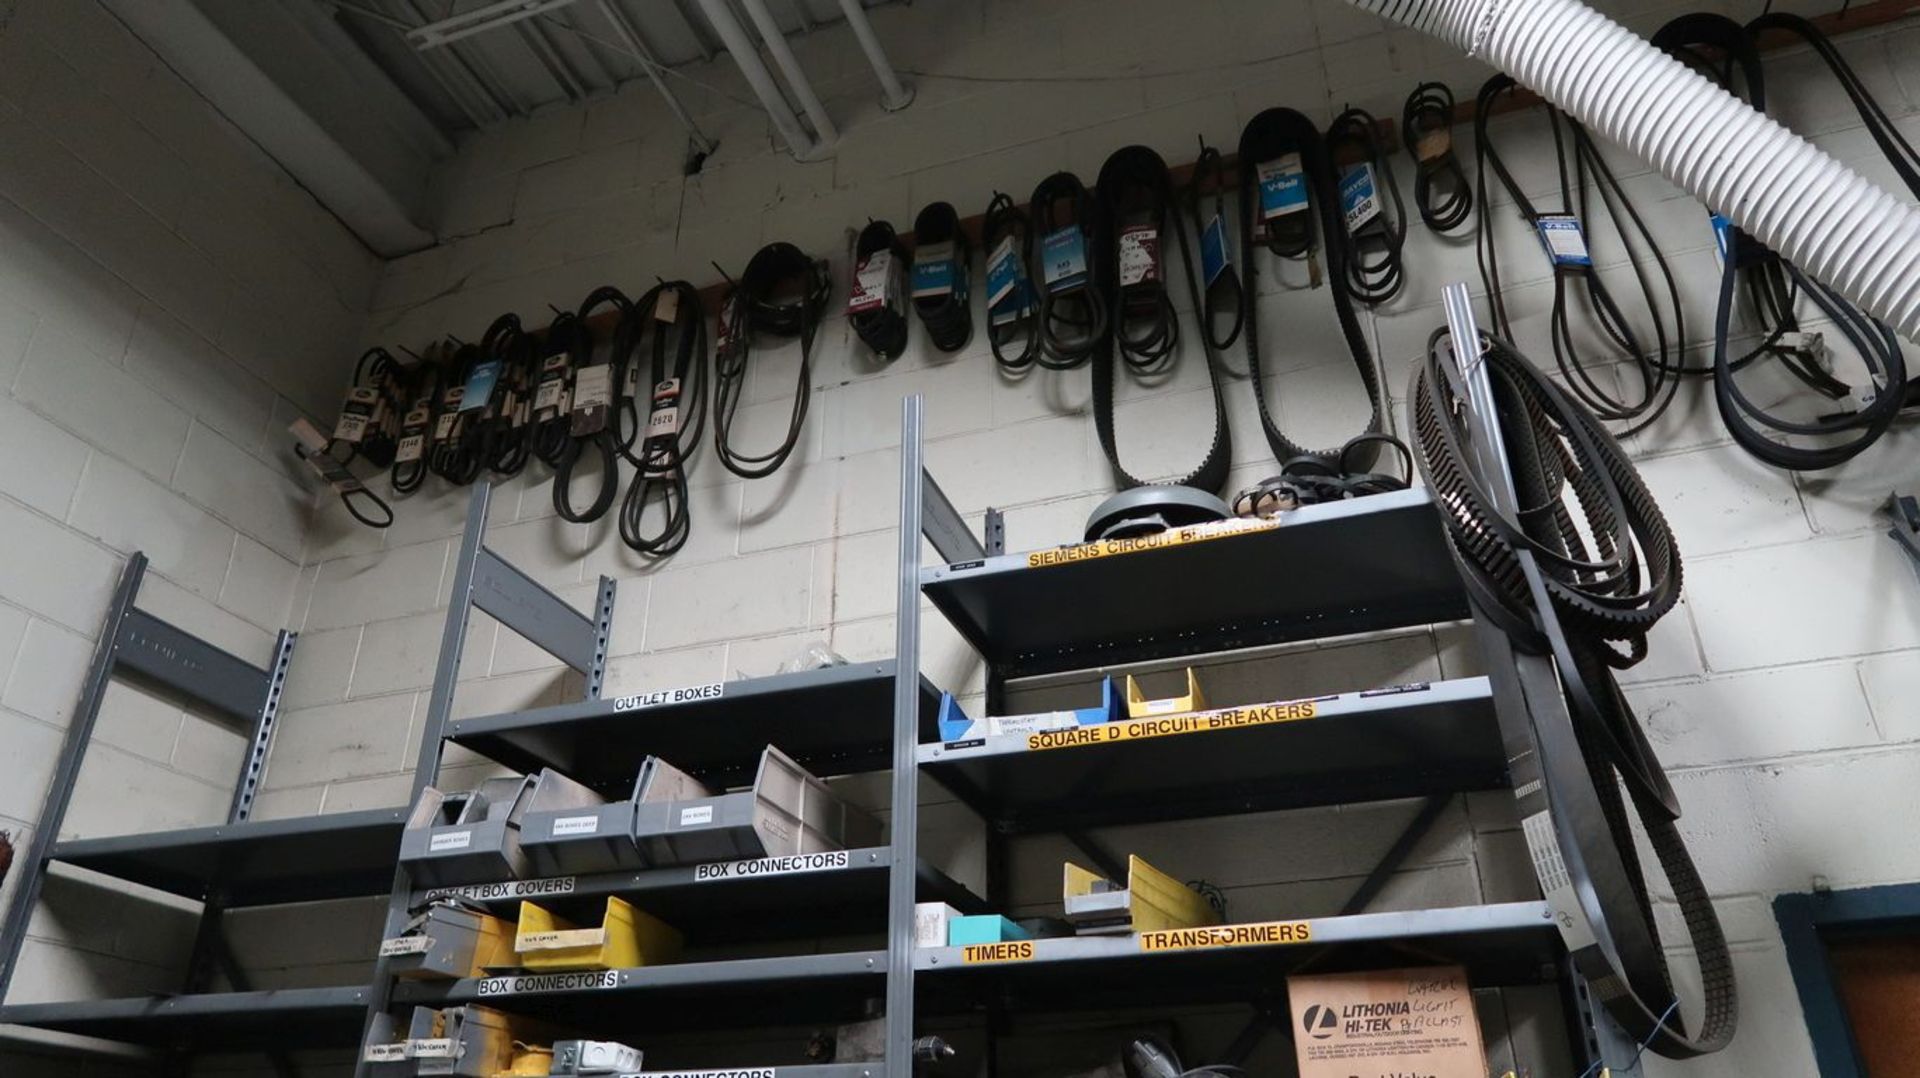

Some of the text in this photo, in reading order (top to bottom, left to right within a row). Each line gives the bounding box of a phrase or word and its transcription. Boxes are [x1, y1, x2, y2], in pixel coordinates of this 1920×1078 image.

[1267, 178, 1299, 192] V-Belt
[1029, 544, 1100, 567] SIEMENS
[615, 684, 721, 710] OUTLET BOXES
[1029, 703, 1313, 750] SQUARE D CIRCUIT BREAKERS
[698, 852, 847, 879] BOX CONNECTORS
[482, 884, 510, 898] BOX
[515, 878, 573, 896] COVERS
[1142, 924, 1309, 949] TRANSFORMERS
[965, 942, 1032, 962] TIMERS
[479, 972, 617, 995] BOX CONNECTORS
[1342, 1001, 1411, 1018] LITHONIA
[1345, 1018, 1392, 1034] HI-TEK
